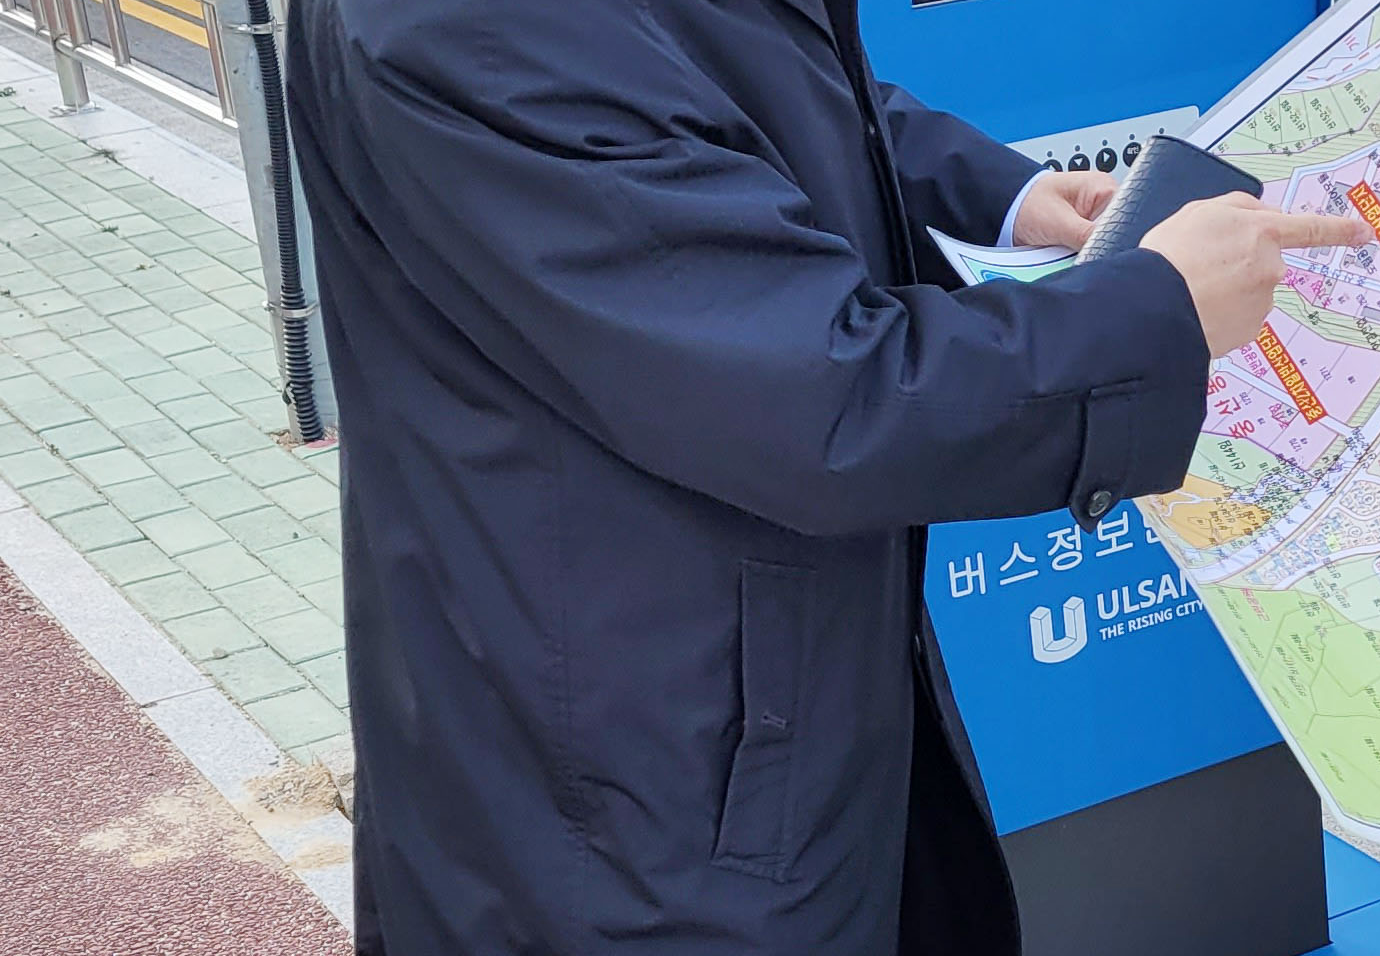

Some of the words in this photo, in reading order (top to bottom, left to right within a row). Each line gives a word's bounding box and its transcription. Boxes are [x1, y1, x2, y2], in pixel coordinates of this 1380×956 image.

[1100, 624, 1125, 641] THE
[1128, 609, 1173, 632] RISING
[1175, 599, 1206, 618] CITY
